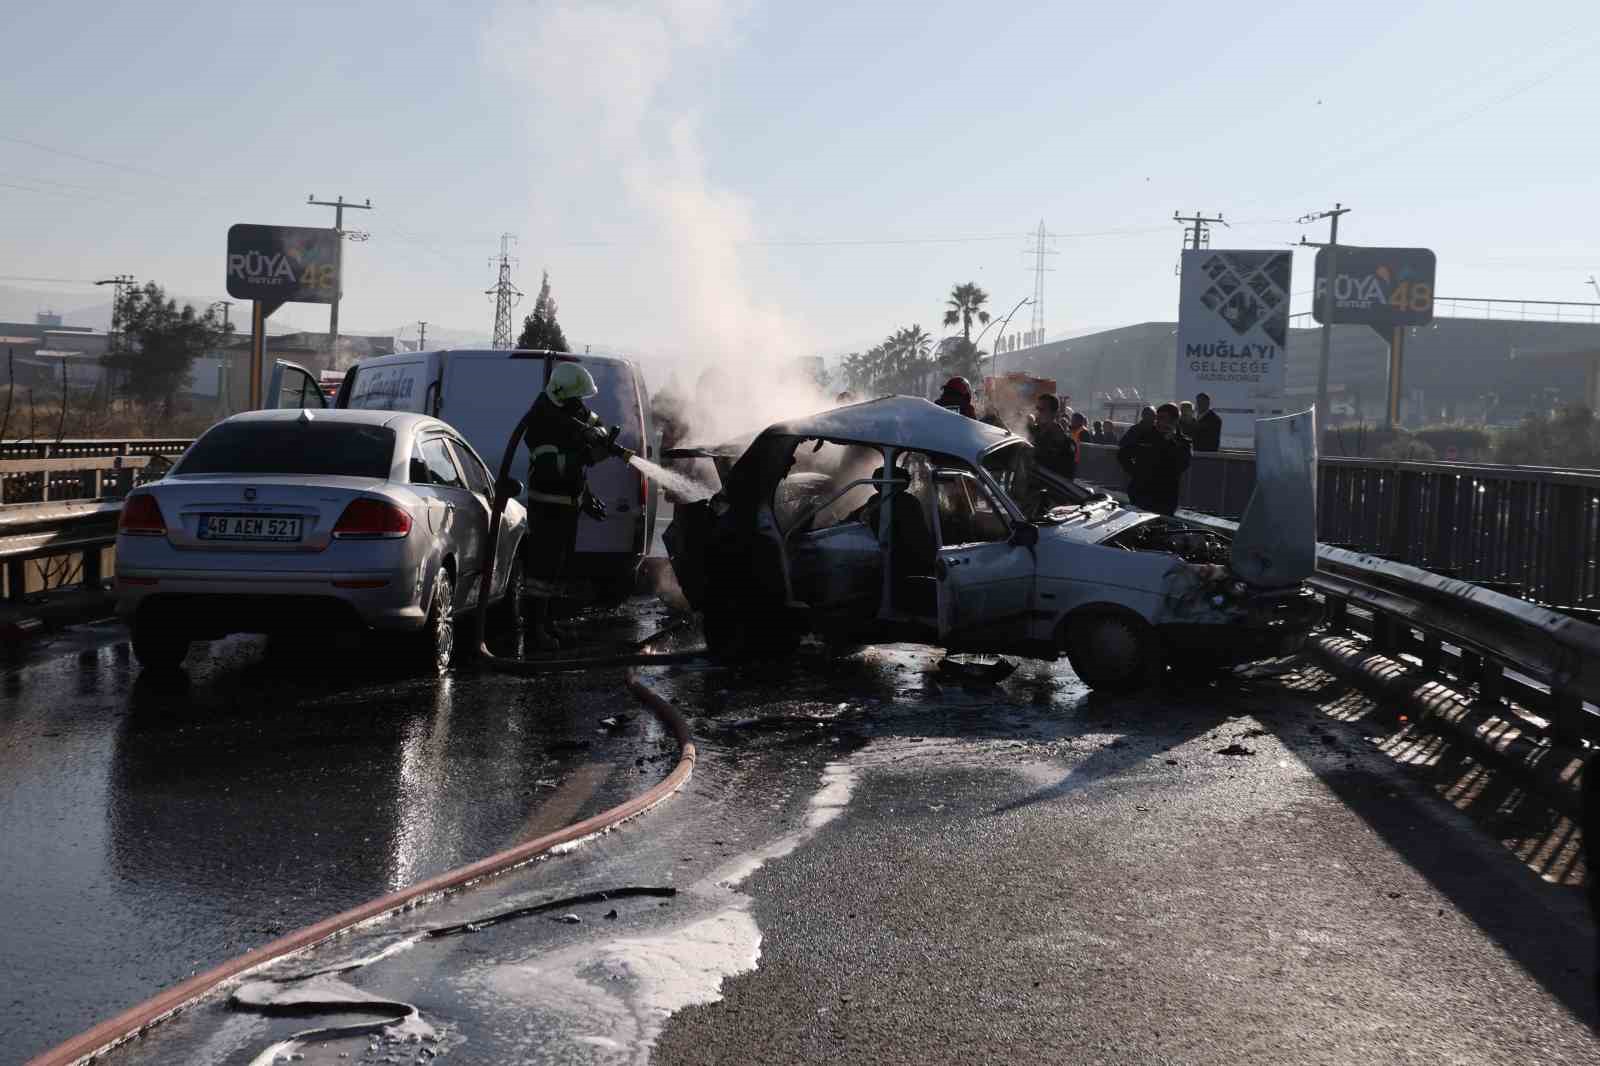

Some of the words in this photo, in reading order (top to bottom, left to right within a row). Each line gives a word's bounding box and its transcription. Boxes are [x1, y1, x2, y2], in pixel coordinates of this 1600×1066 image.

[229, 250, 297, 282] RÜYA
[1391, 281, 1433, 312] 48
[1186, 339, 1275, 359] MUĞLA'YI
[208, 517, 226, 534] 48
[268, 519, 297, 535] 521
